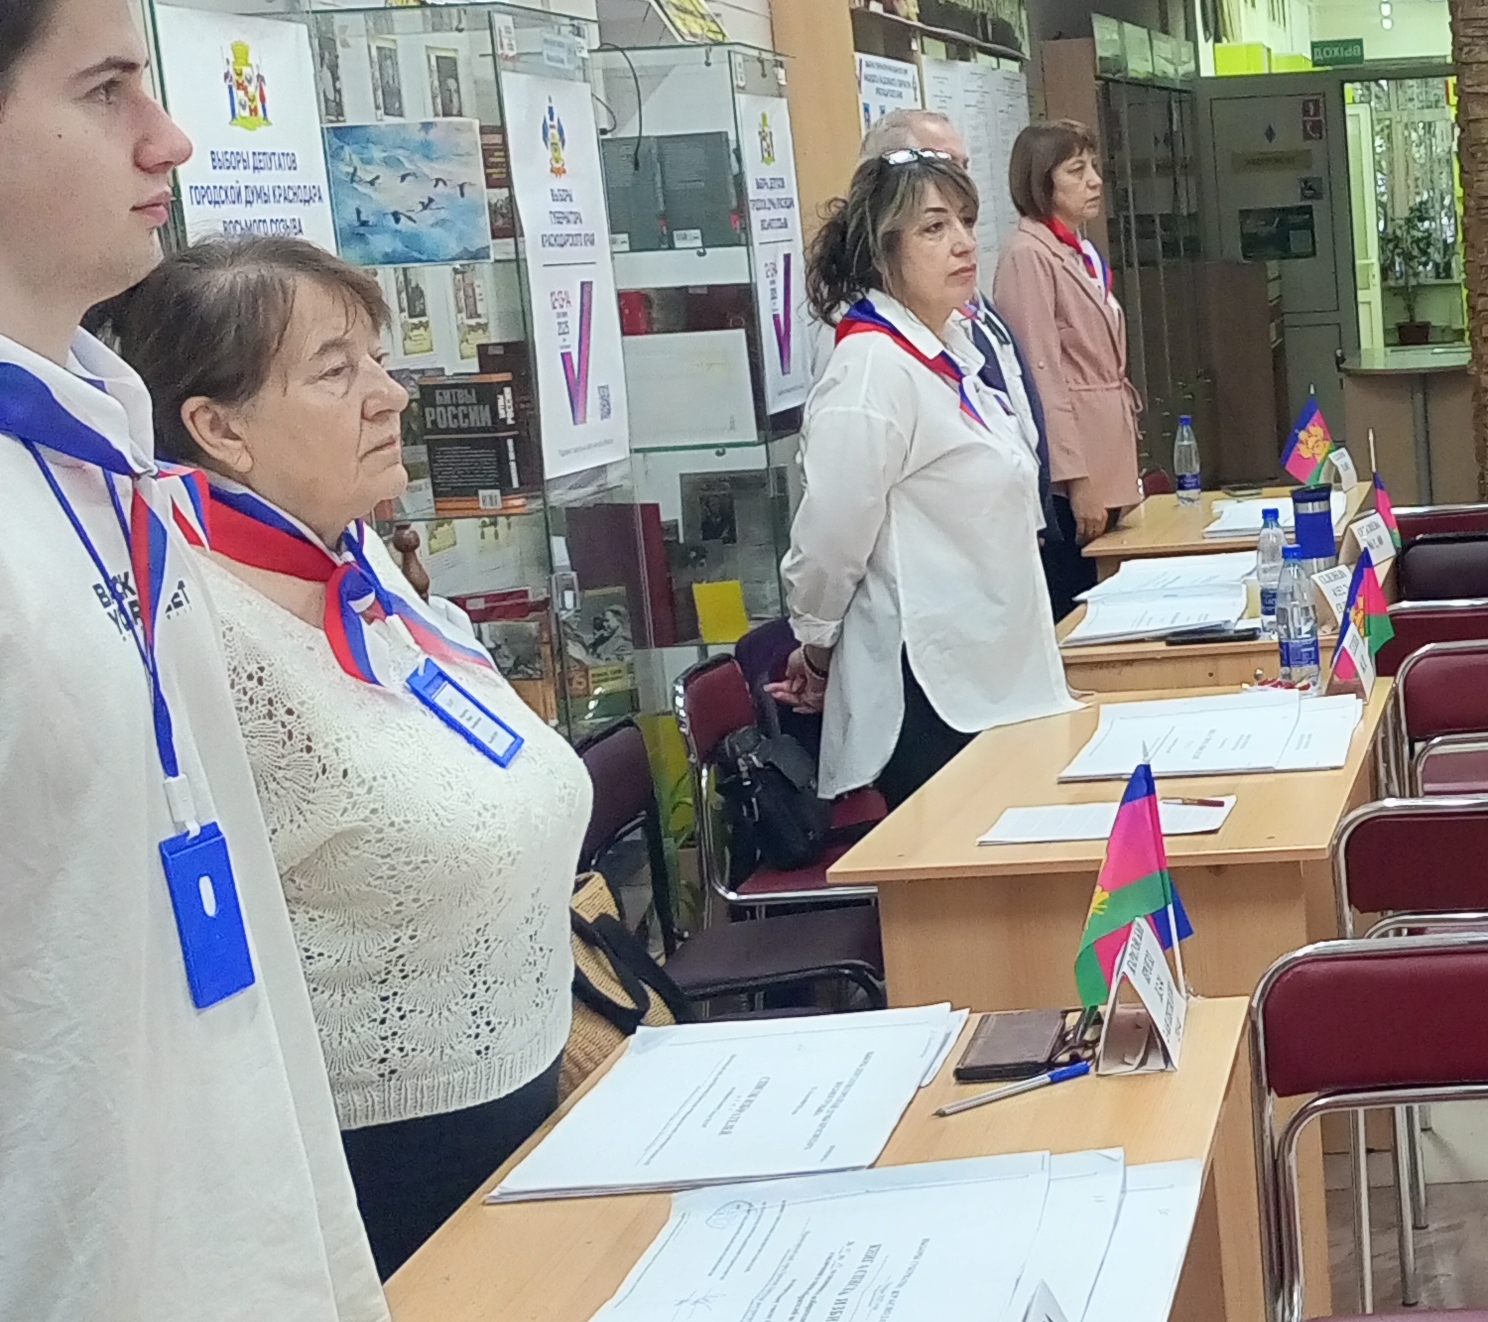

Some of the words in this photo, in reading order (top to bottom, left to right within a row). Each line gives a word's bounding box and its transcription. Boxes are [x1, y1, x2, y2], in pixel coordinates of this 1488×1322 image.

[210, 150, 251, 171] ВЫБОРЫ
[251, 151, 298, 173] ДЕПУТАТОВ
[188, 180, 243, 208] ГОРОДСКОЙ
[244, 185, 271, 208] ДУМЫ
[271, 185, 324, 207] КРАСНОДАРА
[435, 389, 478, 405] БИТВЫ
[425, 404, 493, 429] РОССИИ
